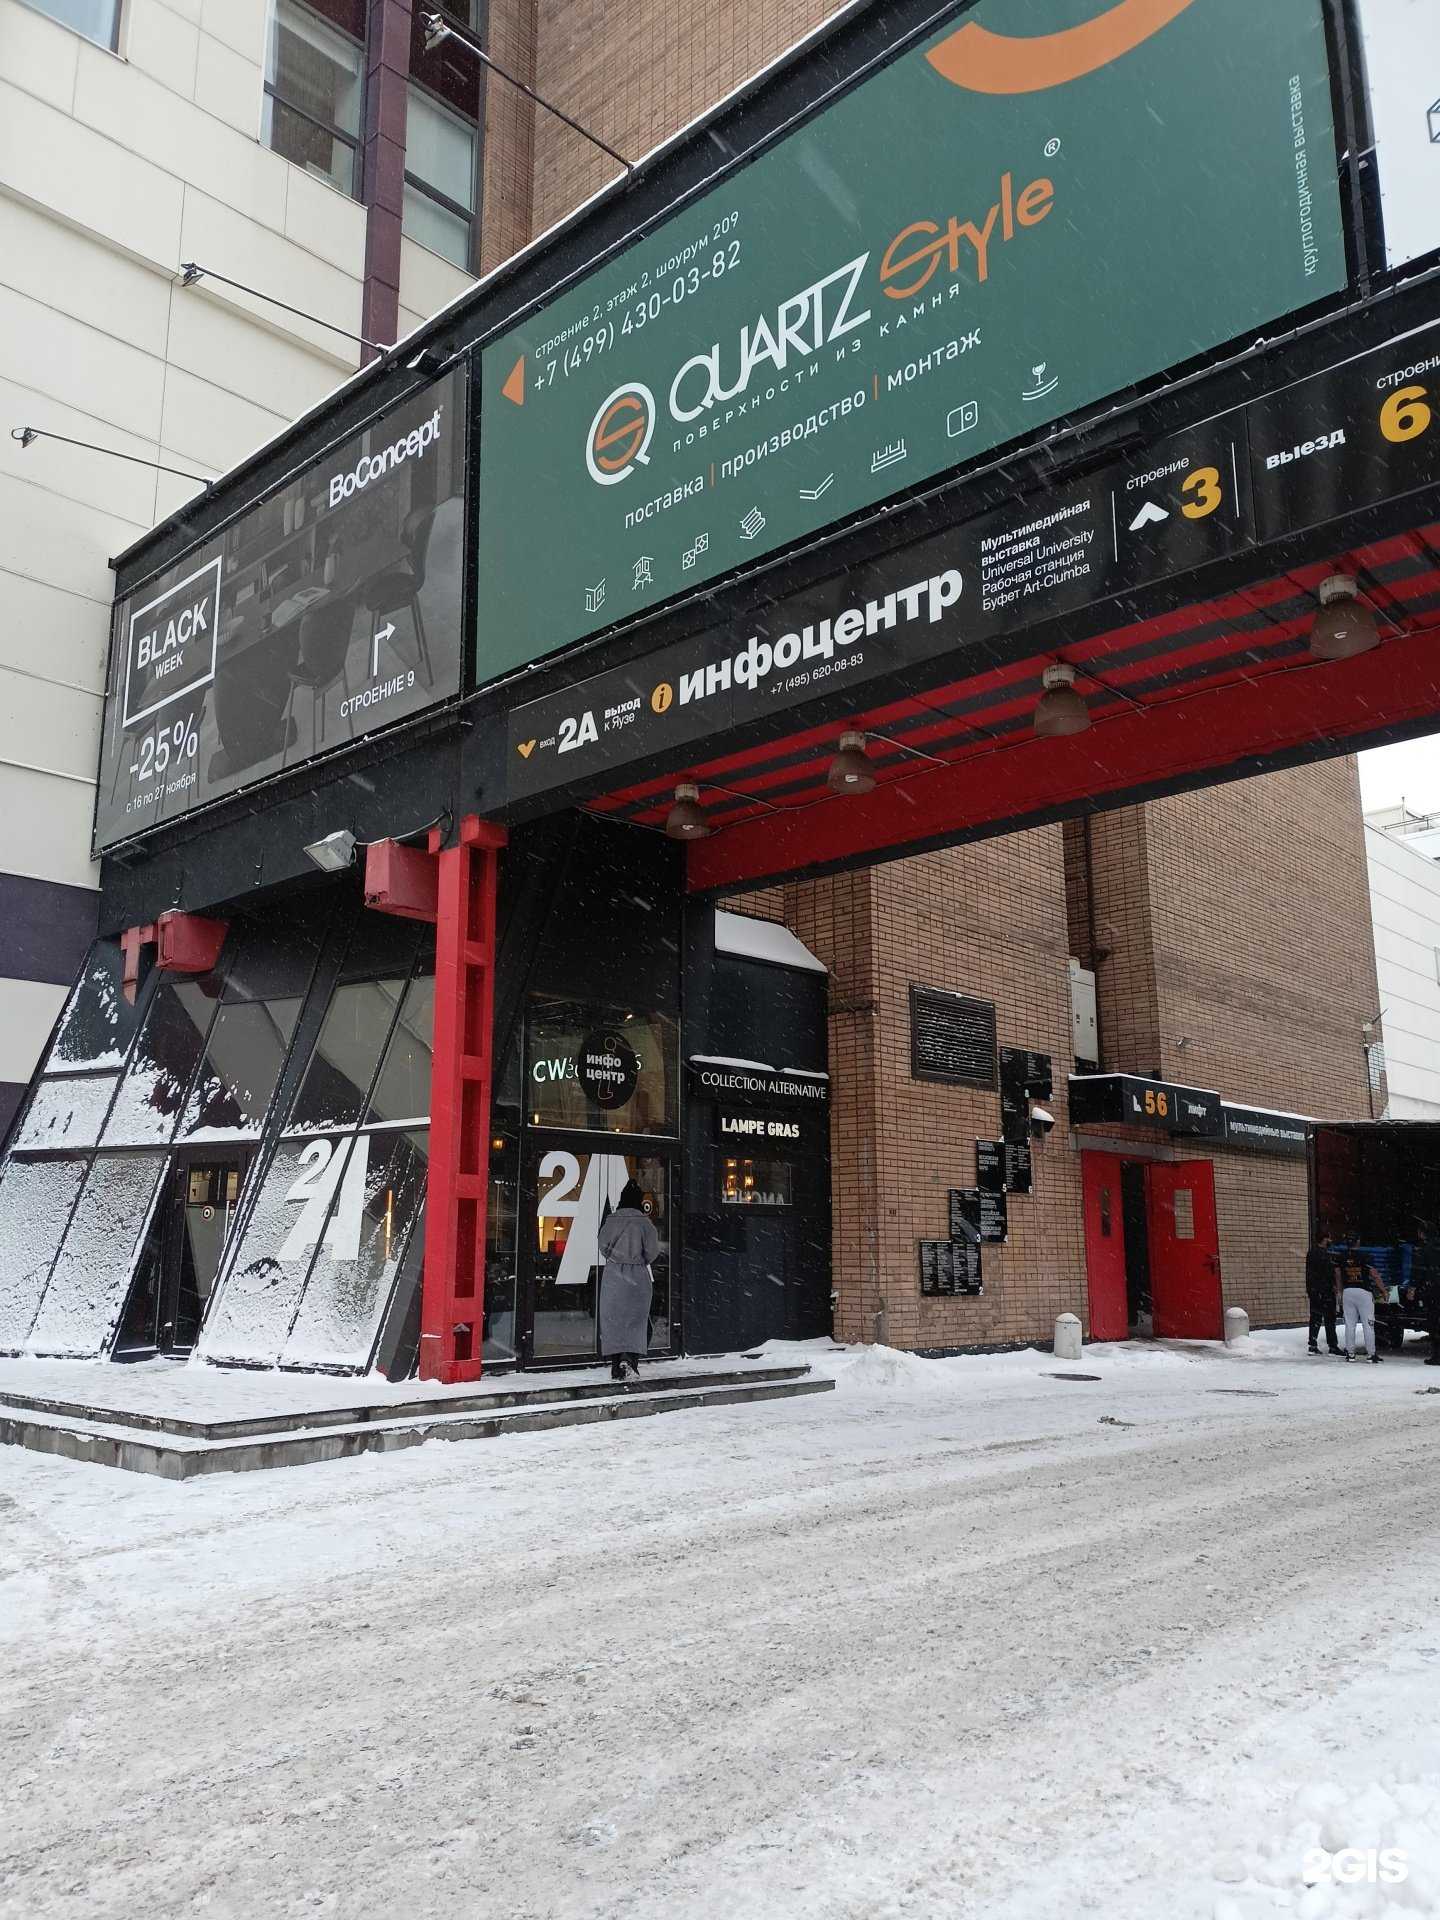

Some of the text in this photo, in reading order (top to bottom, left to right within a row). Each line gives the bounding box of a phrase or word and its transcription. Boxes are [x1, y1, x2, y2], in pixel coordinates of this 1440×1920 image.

[1288, 74, 1319, 277] круглогодичная выставка
[535, 210, 739, 360] строение 2, этаж 2, шоурум 209
[669, 171, 1055, 424] QUARTZ Style
[534, 240, 742, 391] +7 (499) 430-03-82
[879, 283, 960, 337] КАМНЯ
[625, 328, 982, 529] поставка производство монтаж
[1266, 385, 1431, 470] выезд 6
[329, 408, 441, 508] BoConcept
[1126, 456, 1190, 491] строение
[1181, 466, 1222, 519] 3
[981, 499, 1091, 552] Мультимедийная
[981, 536, 1041, 567] выставка
[982, 528, 1095, 581] Universal University
[982, 549, 1085, 596] Рабочая станция
[982, 562, 1091, 611] Буфет Art-Clumba
[137, 597, 209, 670] BLACK
[679, 569, 964, 706] инфоцентр
[154, 653, 185, 680] WEEK
[770, 653, 865, 695] +7 (495) 620-08-83
[340, 670, 416, 718] СТРОЕНИЕ 9
[604, 696, 641, 720] выход
[539, 710, 600, 755] вход 2А
[604, 711, 636, 732] к Яузе
[129, 713, 198, 782] -25%
[133, 794, 143, 811] 16
[143, 793, 154, 809] по
[154, 785, 165, 804] 27
[165, 772, 197, 801] ноября
[586, 1053, 622, 1071] инфо
[586, 1068, 626, 1084] центр
[701, 1072, 827, 1099] COLLECTION ALTERNATIVE
[721, 1117, 800, 1138] LAMPE GRAS
